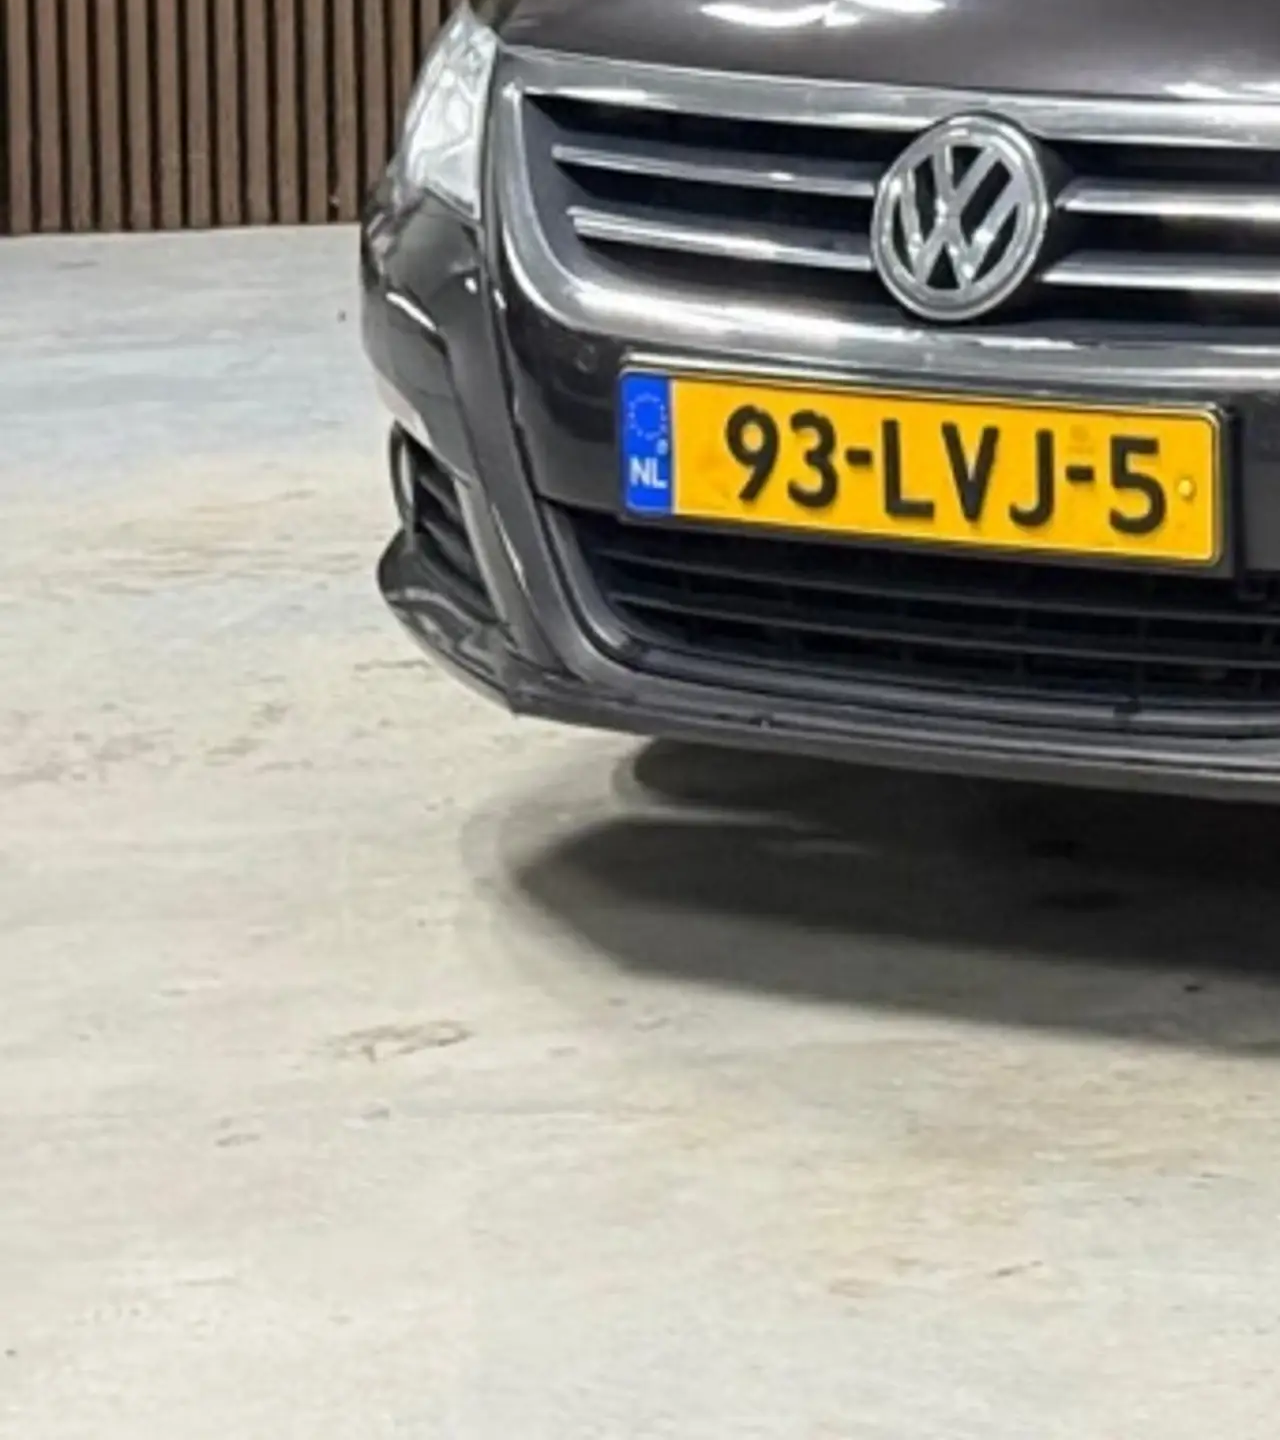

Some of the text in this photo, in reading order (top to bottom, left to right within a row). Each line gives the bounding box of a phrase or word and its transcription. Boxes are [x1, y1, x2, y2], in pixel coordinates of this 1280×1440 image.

[882, 130, 1038, 306] VW
[629, 455, 668, 490] NL
[724, 404, 1168, 535] 93-LVJ-5
